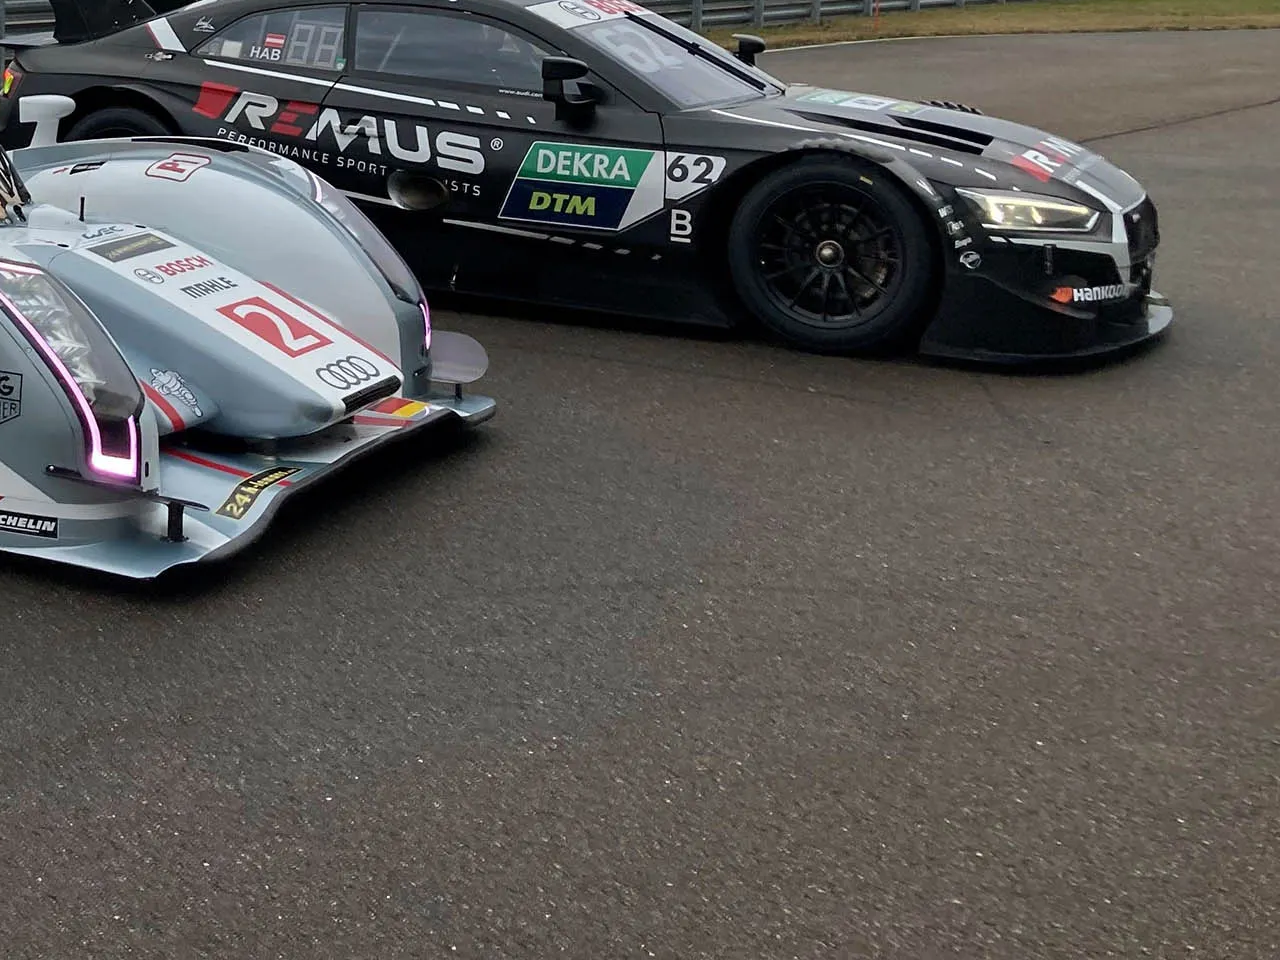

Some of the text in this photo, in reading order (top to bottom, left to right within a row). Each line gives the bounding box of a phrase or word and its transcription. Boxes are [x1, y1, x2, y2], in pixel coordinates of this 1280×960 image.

[250, 45, 282, 61] HAB
[224, 91, 486, 174] REMUS
[217, 127, 388, 177] PERFORMANCE SPORT
[536, 148, 631, 181] DEKRA
[667, 155, 715, 184] 62
[528, 191, 596, 217] DTM
[670, 208, 693, 236] B
[155, 255, 214, 277] BOSCH
[180, 276, 239, 299] MAHLE
[233, 303, 321, 351] 2
